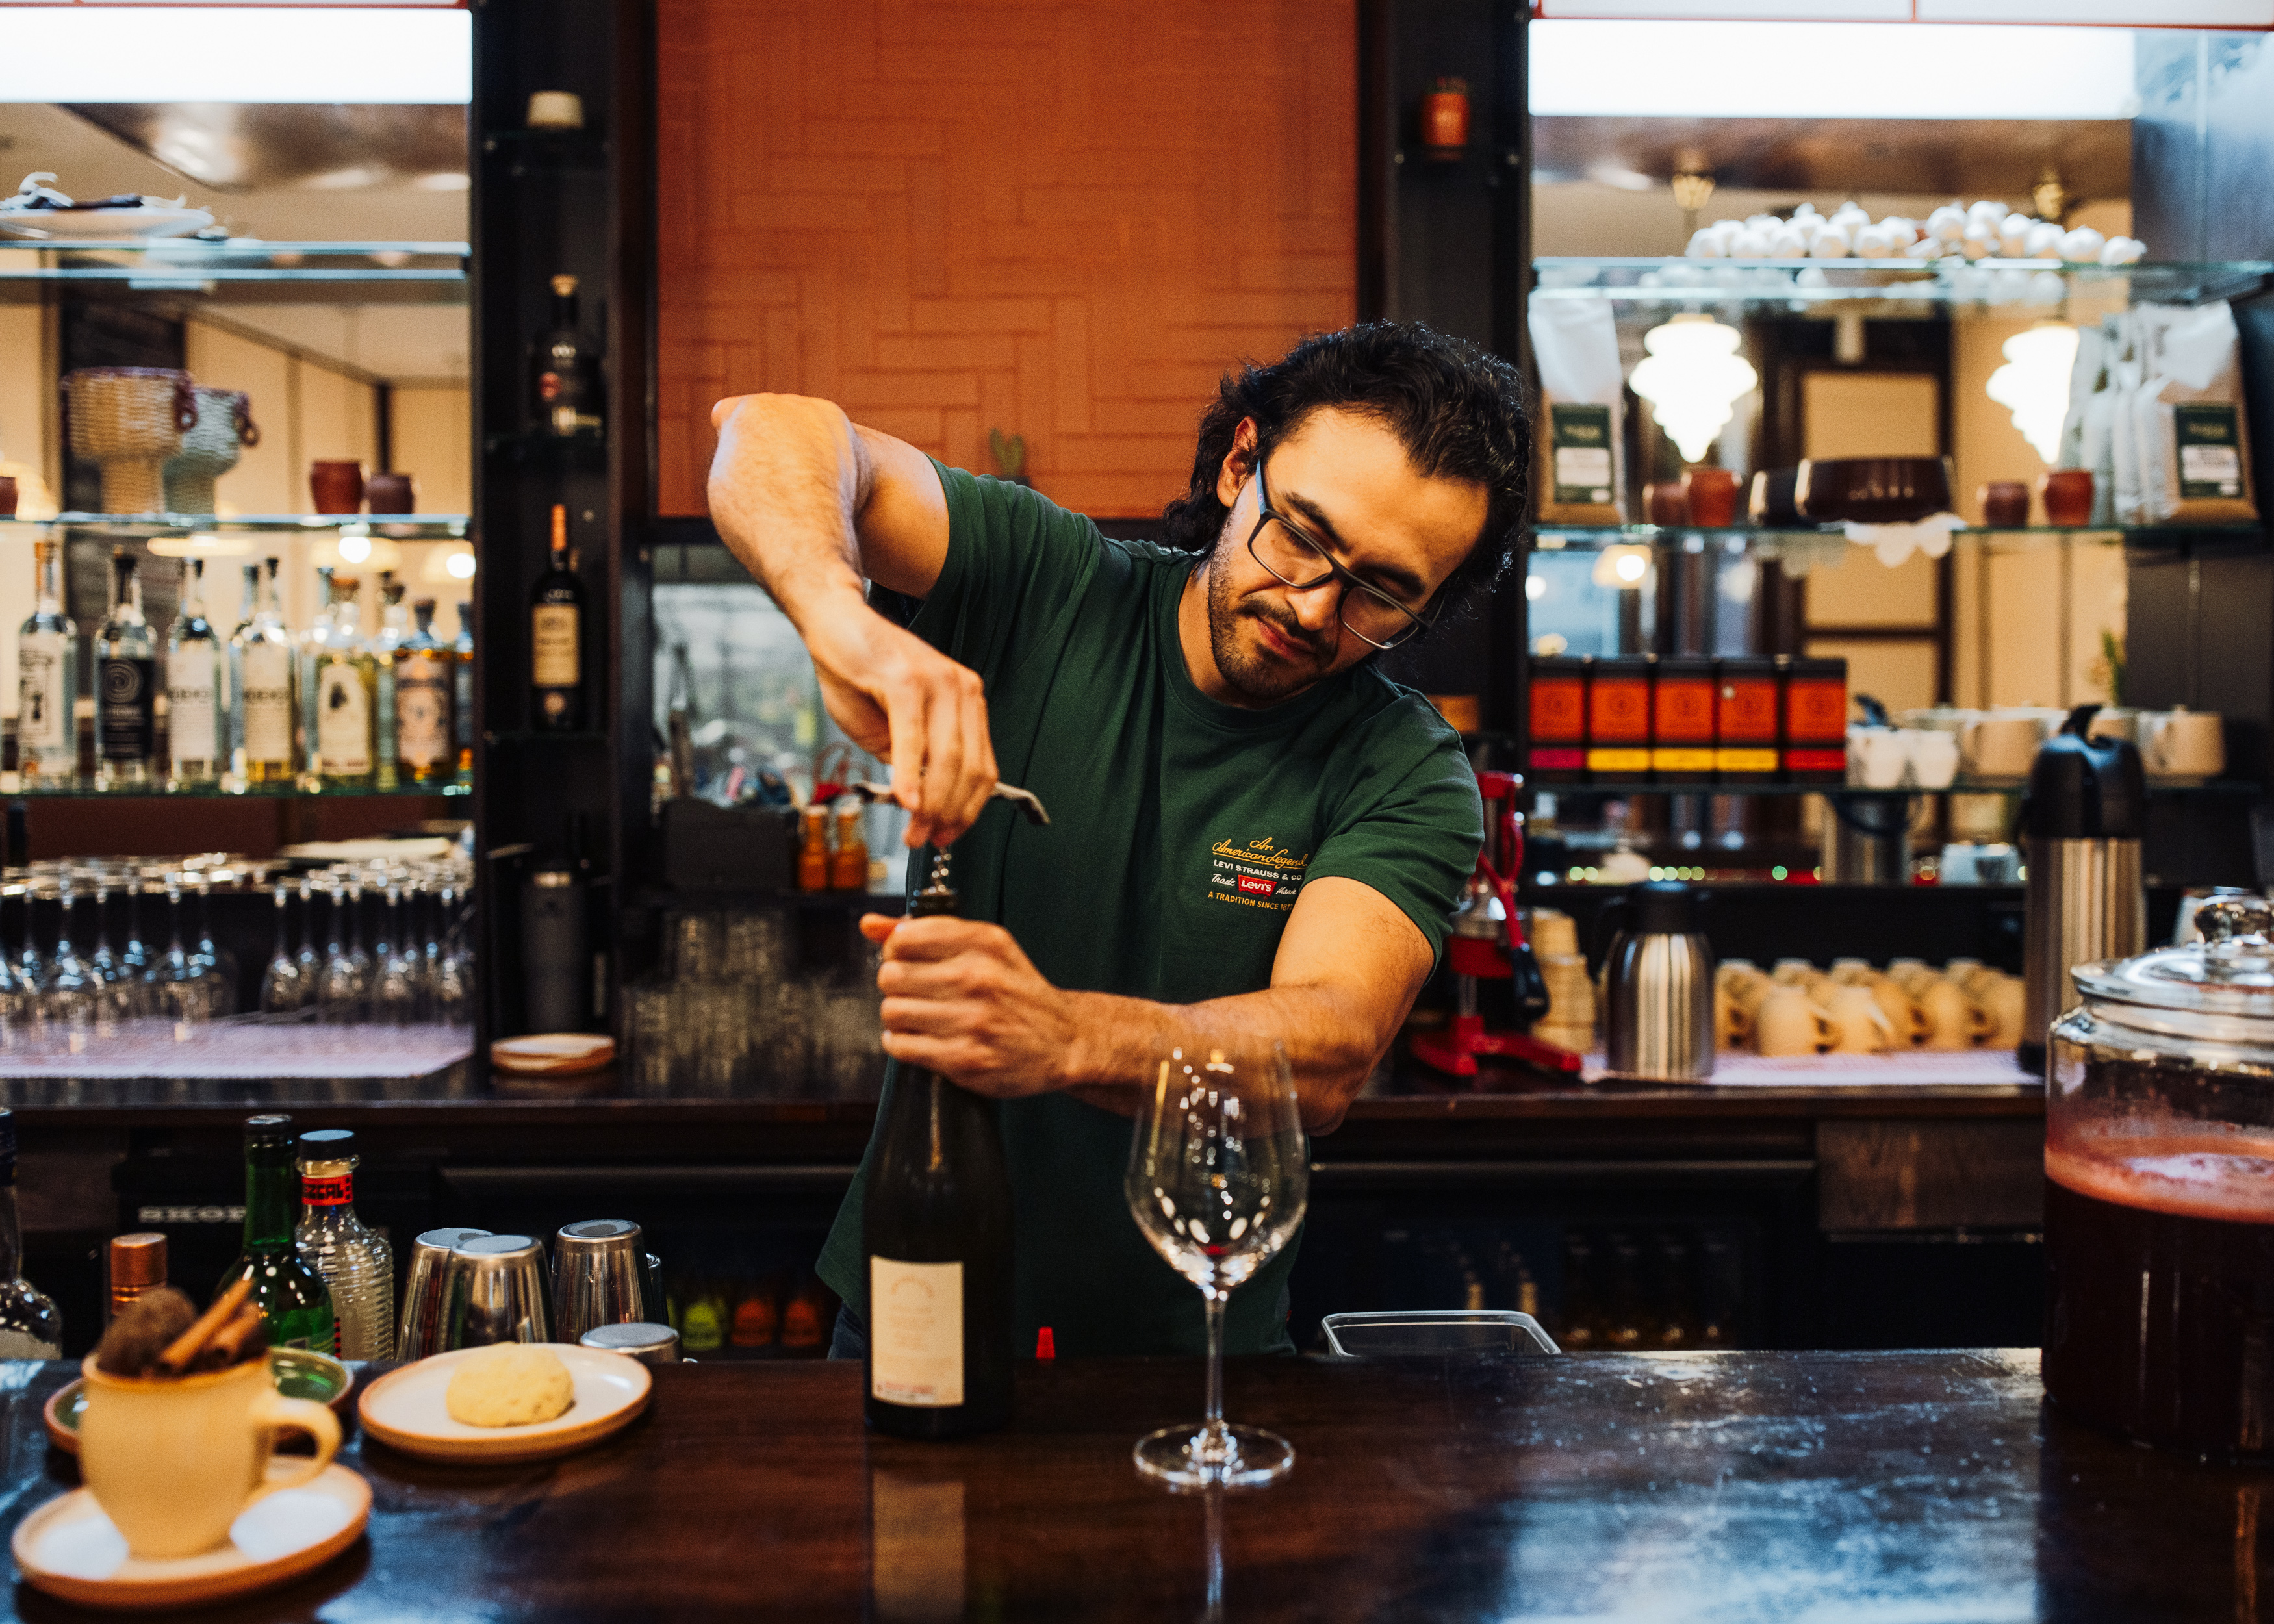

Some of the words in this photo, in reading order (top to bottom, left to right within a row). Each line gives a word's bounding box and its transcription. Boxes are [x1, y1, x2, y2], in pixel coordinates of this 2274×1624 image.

[1212, 839, 1266, 861] American
[1265, 848, 1308, 869] Legend
[1249, 837, 1275, 852] An
[1213, 859, 1234, 870] LEVI
[1235, 865, 1280, 879] STRAUSS
[1211, 873, 1236, 887] Trade
[1275, 886, 1297, 895] Mark
[1216, 892, 1255, 906] TRADITION
[1257, 900, 1279, 910] SINCE
